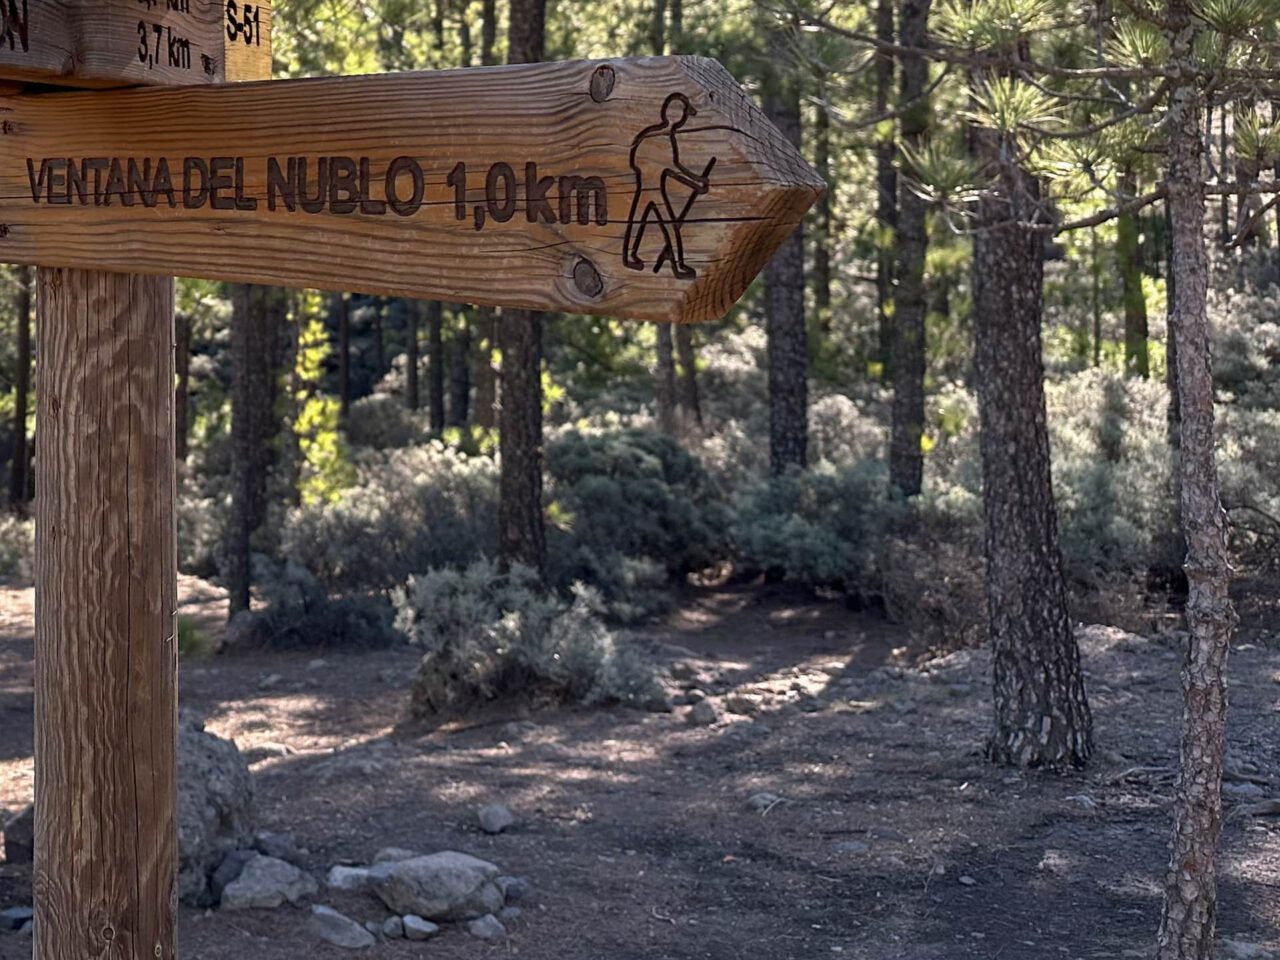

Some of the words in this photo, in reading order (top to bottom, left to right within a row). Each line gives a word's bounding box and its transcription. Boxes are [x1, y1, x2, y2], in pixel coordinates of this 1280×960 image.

[137, 20, 162, 69] 3,7
[167, 26, 191, 70] km
[226, 0, 260, 47] S-51
[26, 157, 177, 208] VENTANA
[183, 157, 258, 211] DEL
[267, 156, 425, 217] NUBLO
[446, 160, 517, 232] 1,0
[524, 160, 608, 227] km
